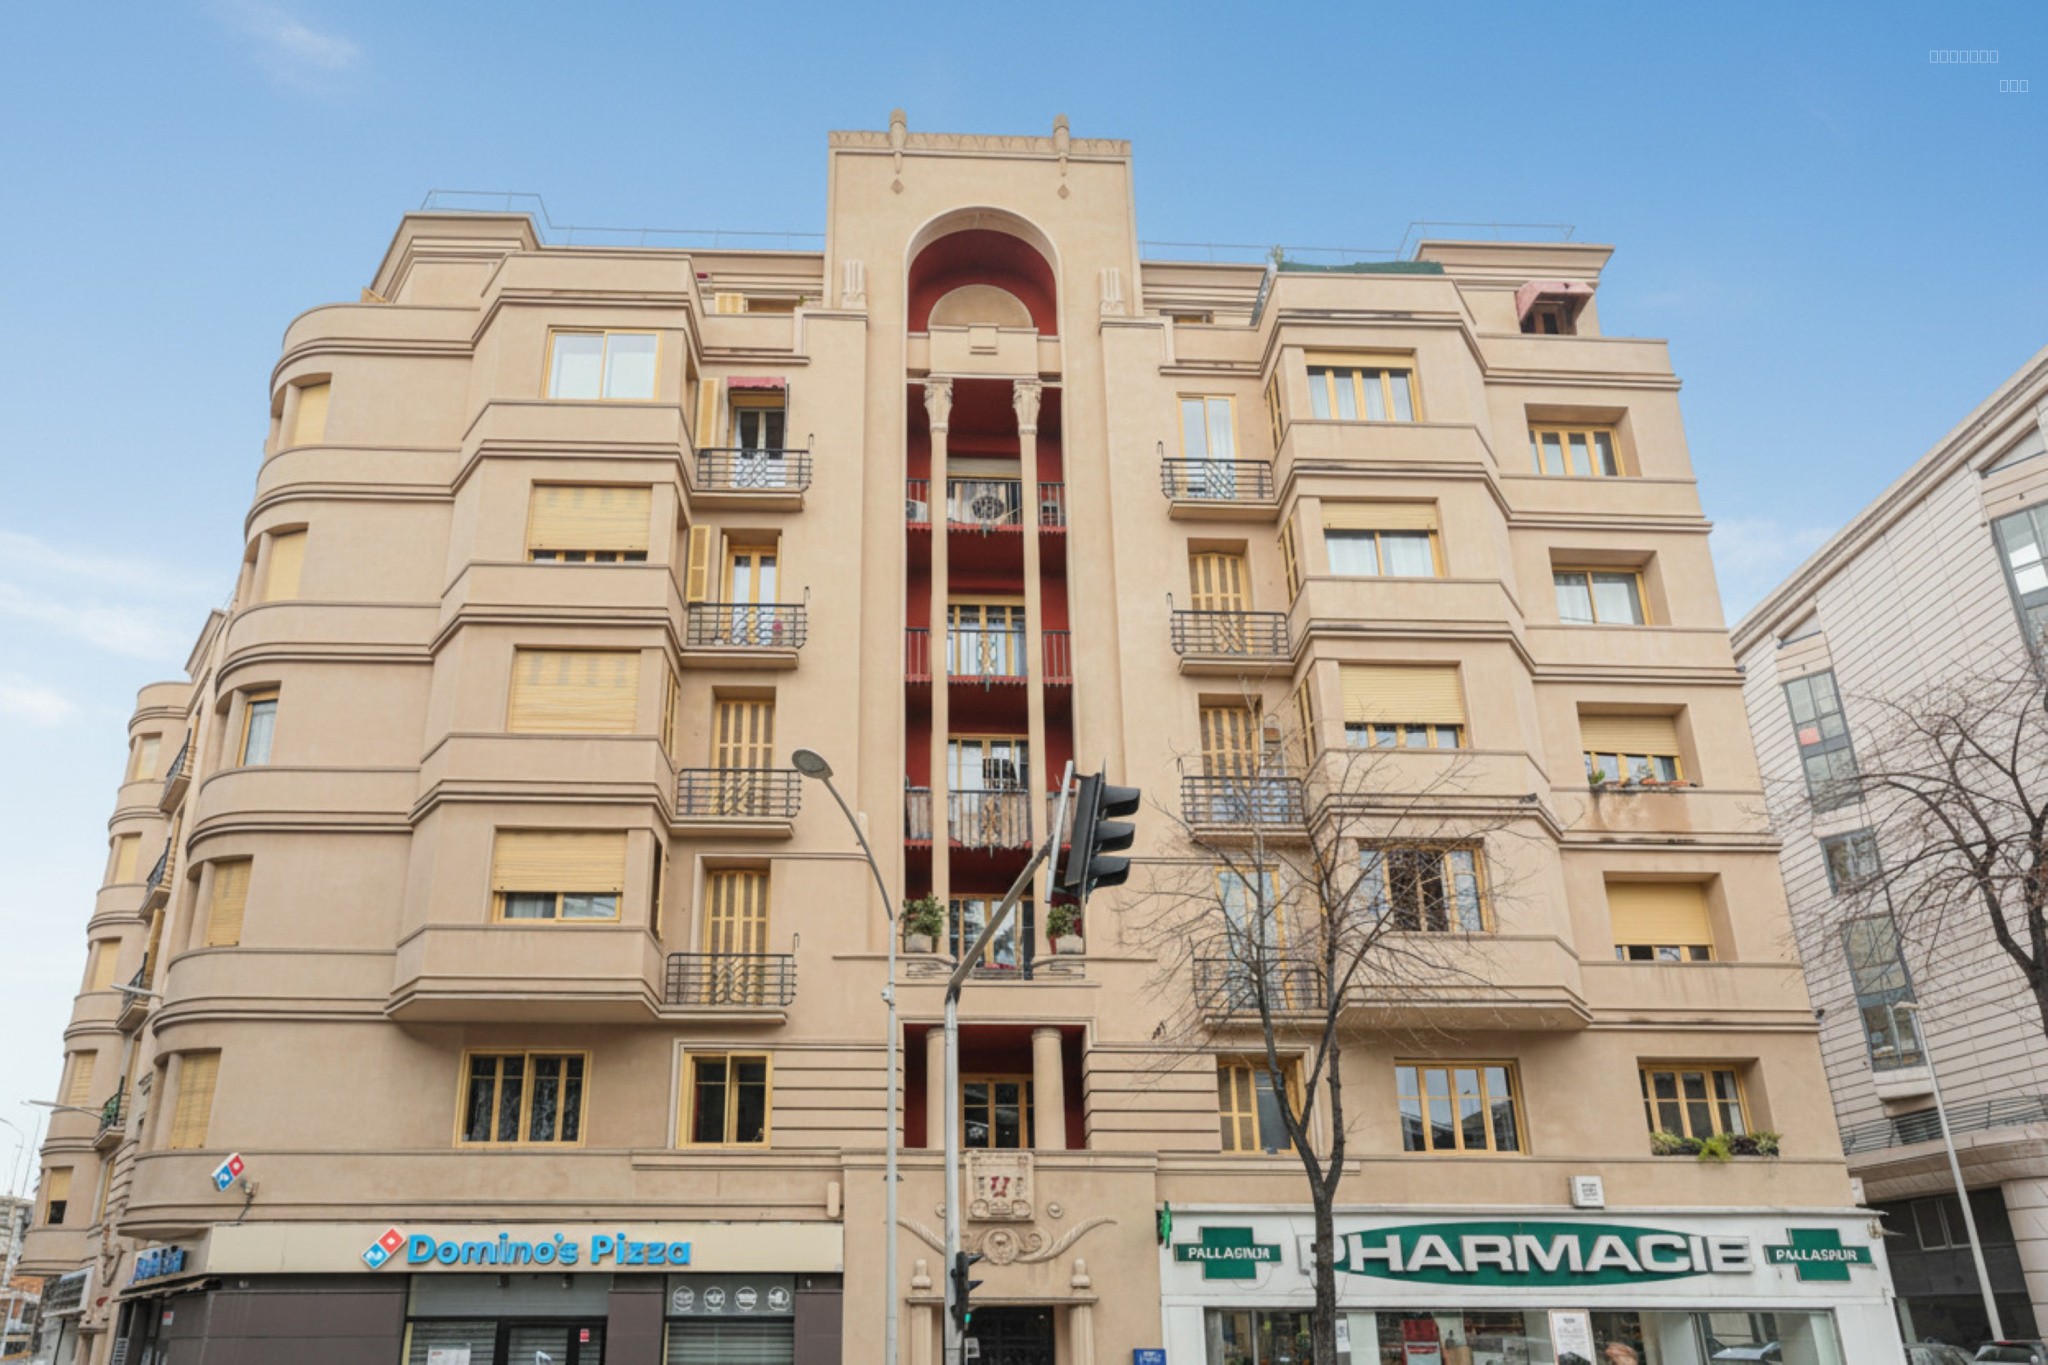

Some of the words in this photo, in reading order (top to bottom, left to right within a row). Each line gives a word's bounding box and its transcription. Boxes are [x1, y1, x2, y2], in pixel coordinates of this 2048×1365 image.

[407, 1232, 579, 1265] Domino's
[590, 1232, 692, 1265] Pizza
[1297, 1234, 1753, 1275] PHARMACIE
